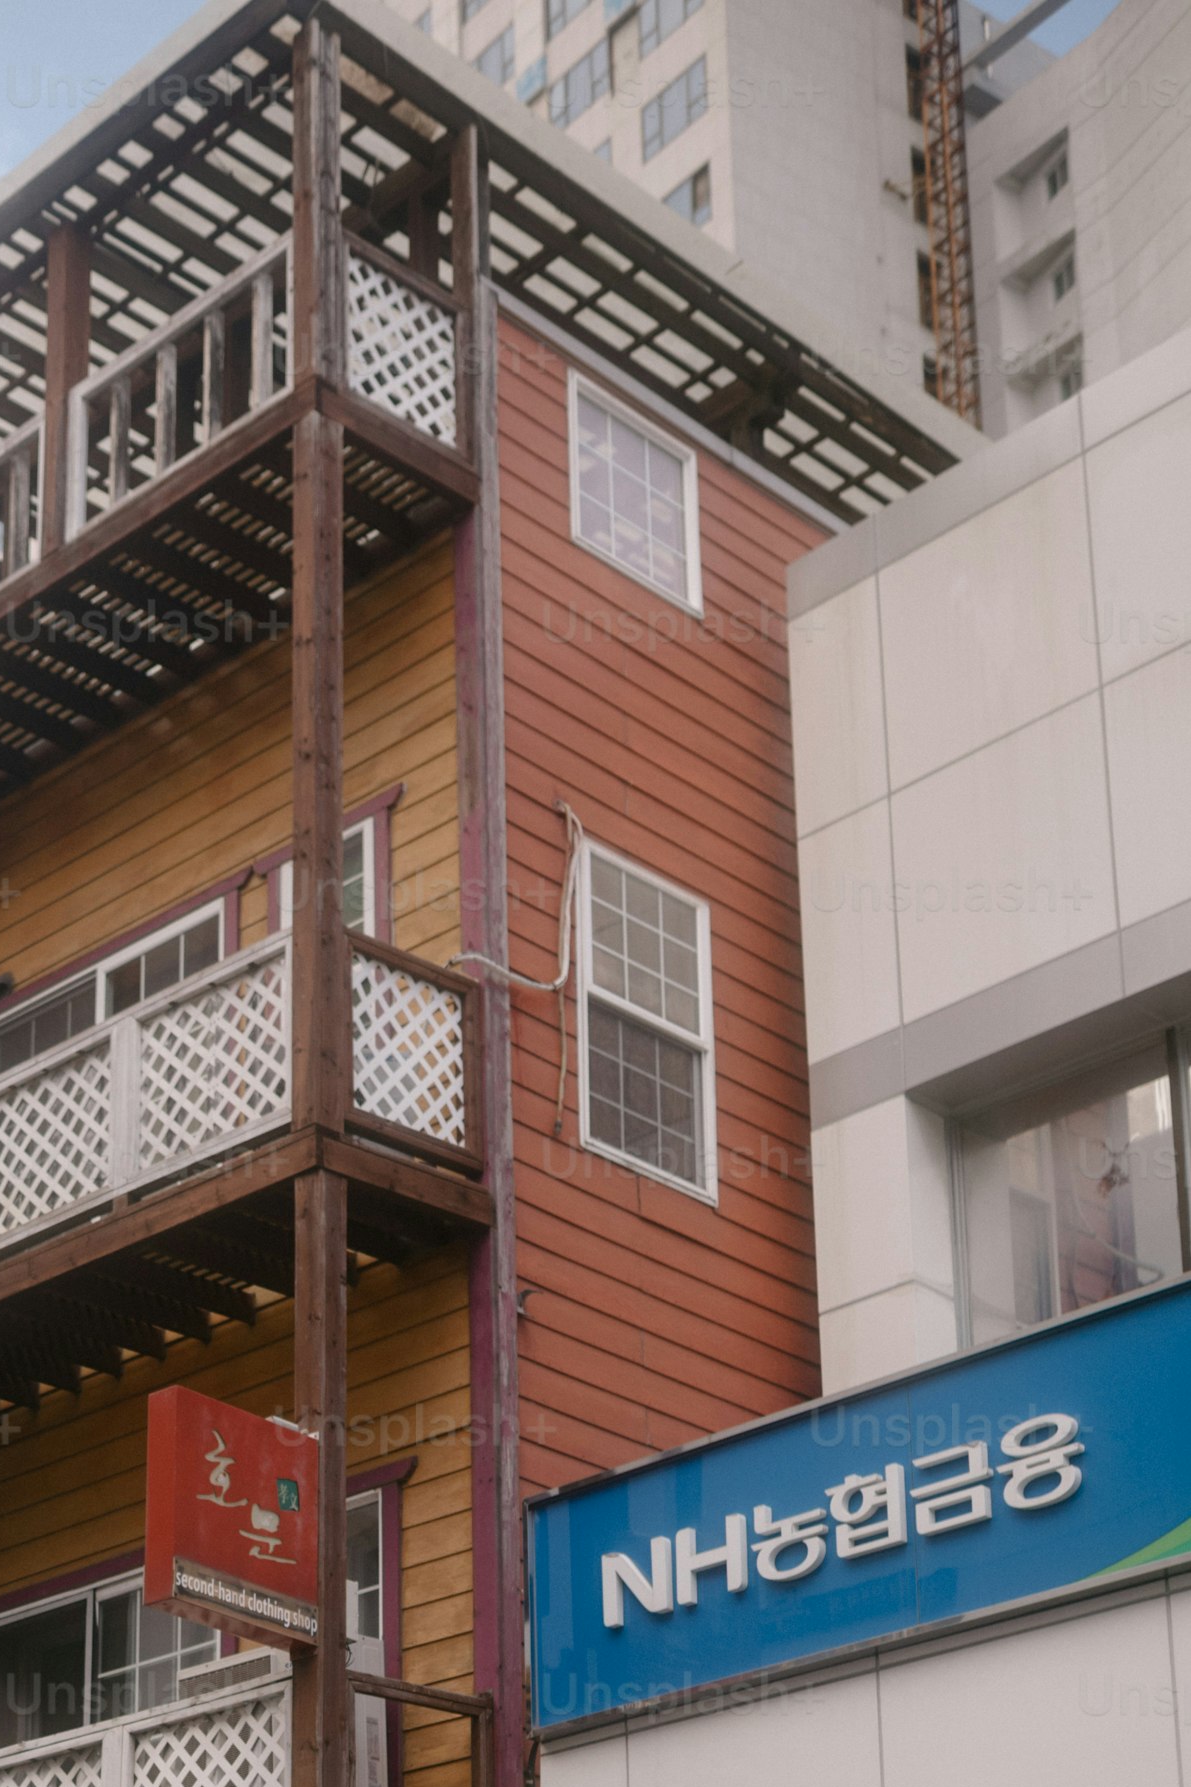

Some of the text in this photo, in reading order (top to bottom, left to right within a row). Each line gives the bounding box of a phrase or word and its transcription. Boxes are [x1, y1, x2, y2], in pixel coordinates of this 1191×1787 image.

[175, 1571, 318, 1637] second-hand clothing shop
